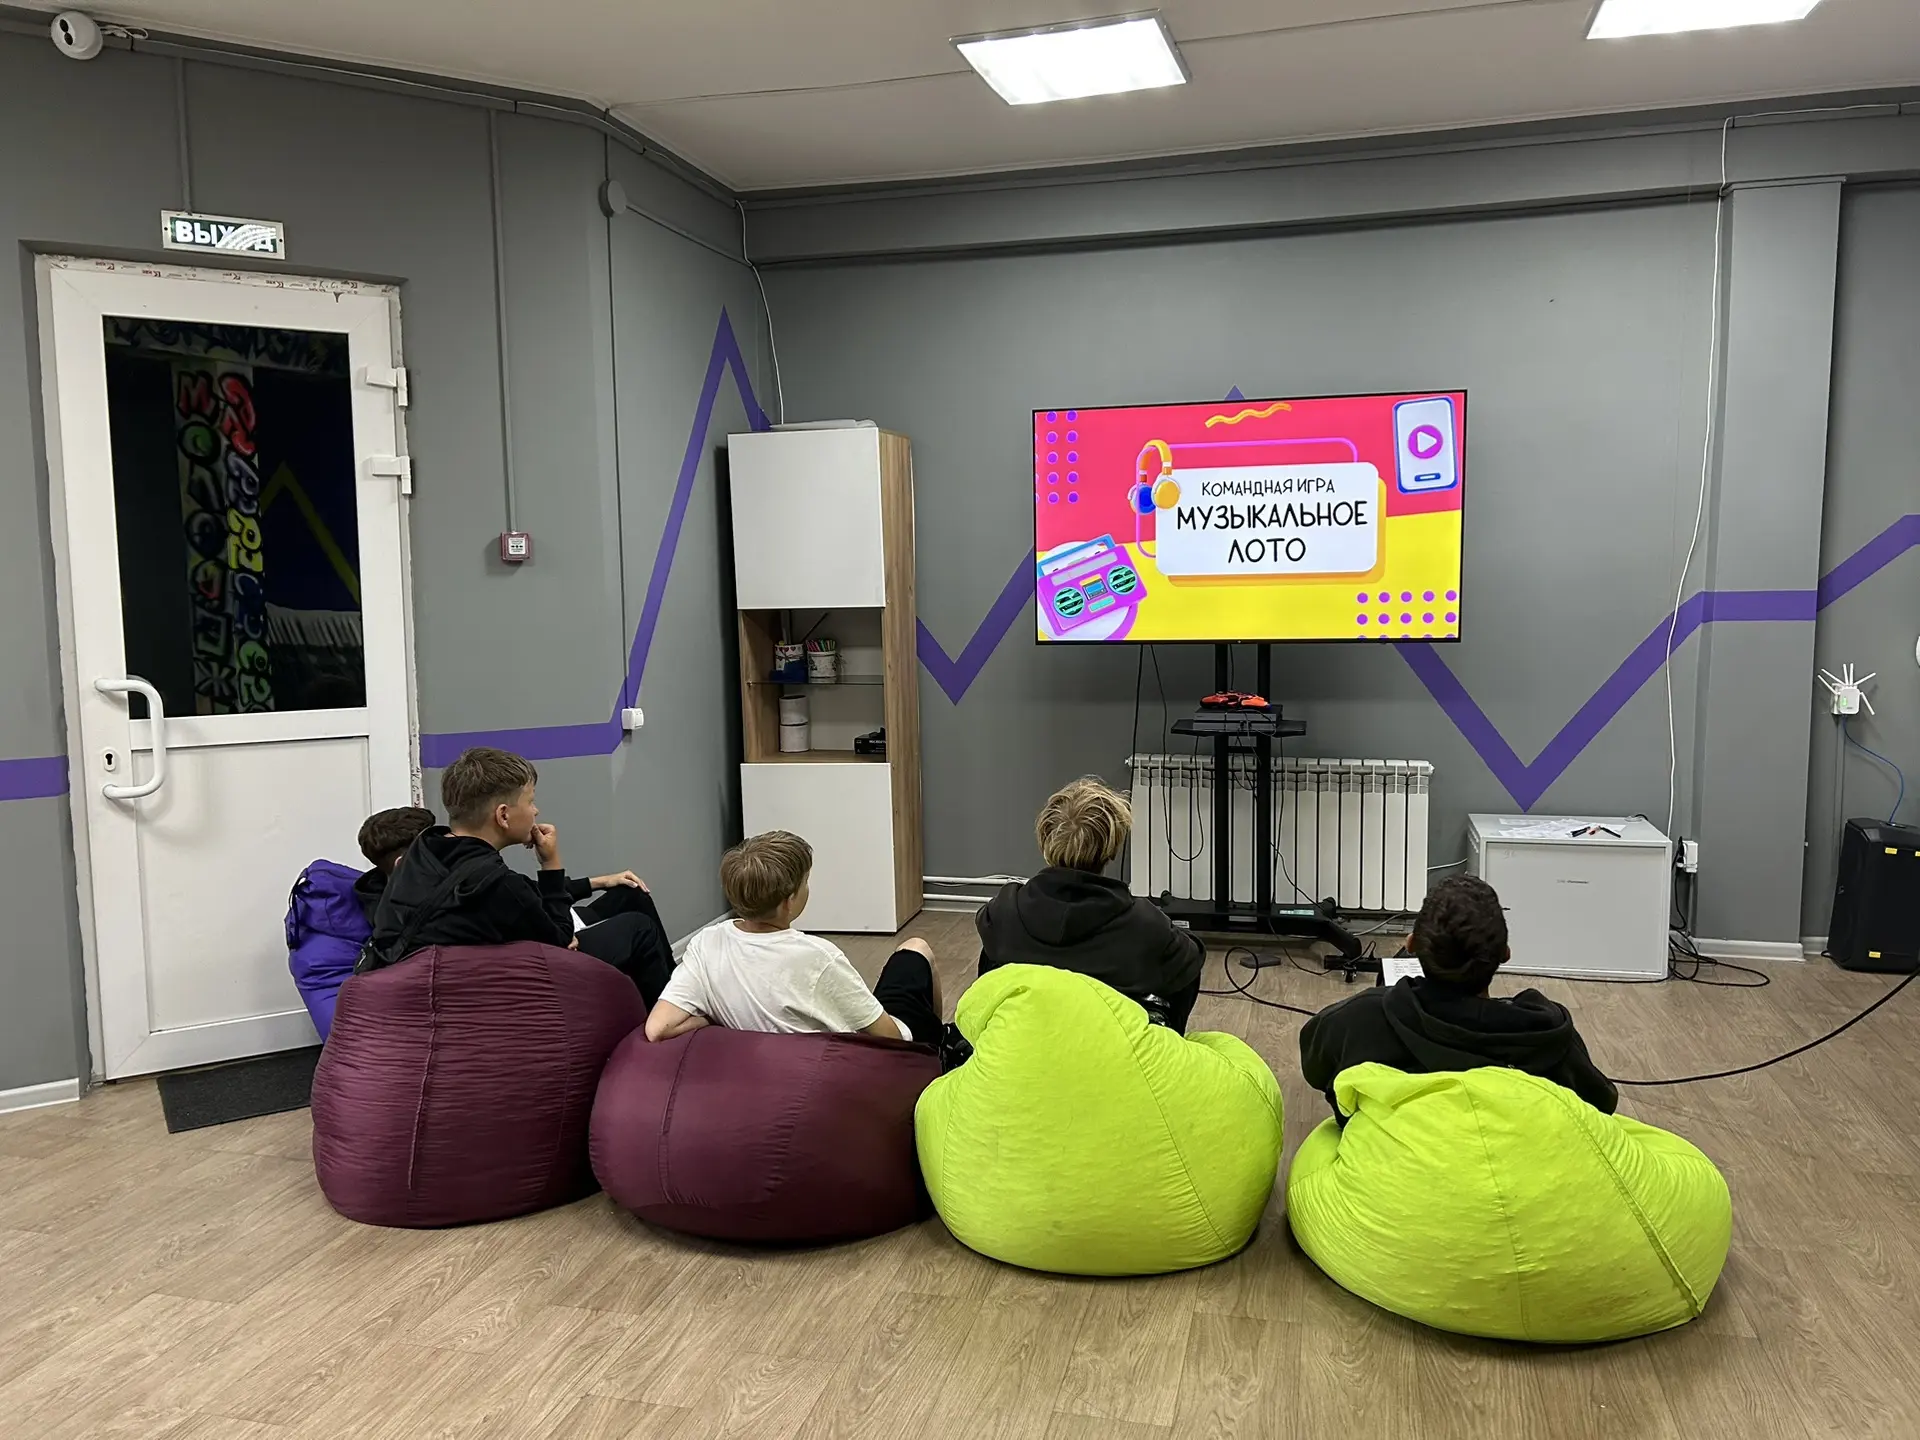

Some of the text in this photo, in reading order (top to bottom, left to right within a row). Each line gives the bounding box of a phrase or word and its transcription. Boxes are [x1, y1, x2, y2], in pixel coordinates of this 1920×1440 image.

[1201, 477, 1336, 497] КОМАНДНАЯ ИГРА
[1177, 500, 1368, 531] МУЗЫКАЛЬНОЕ
[1227, 537, 1306, 563] ЛОТО
